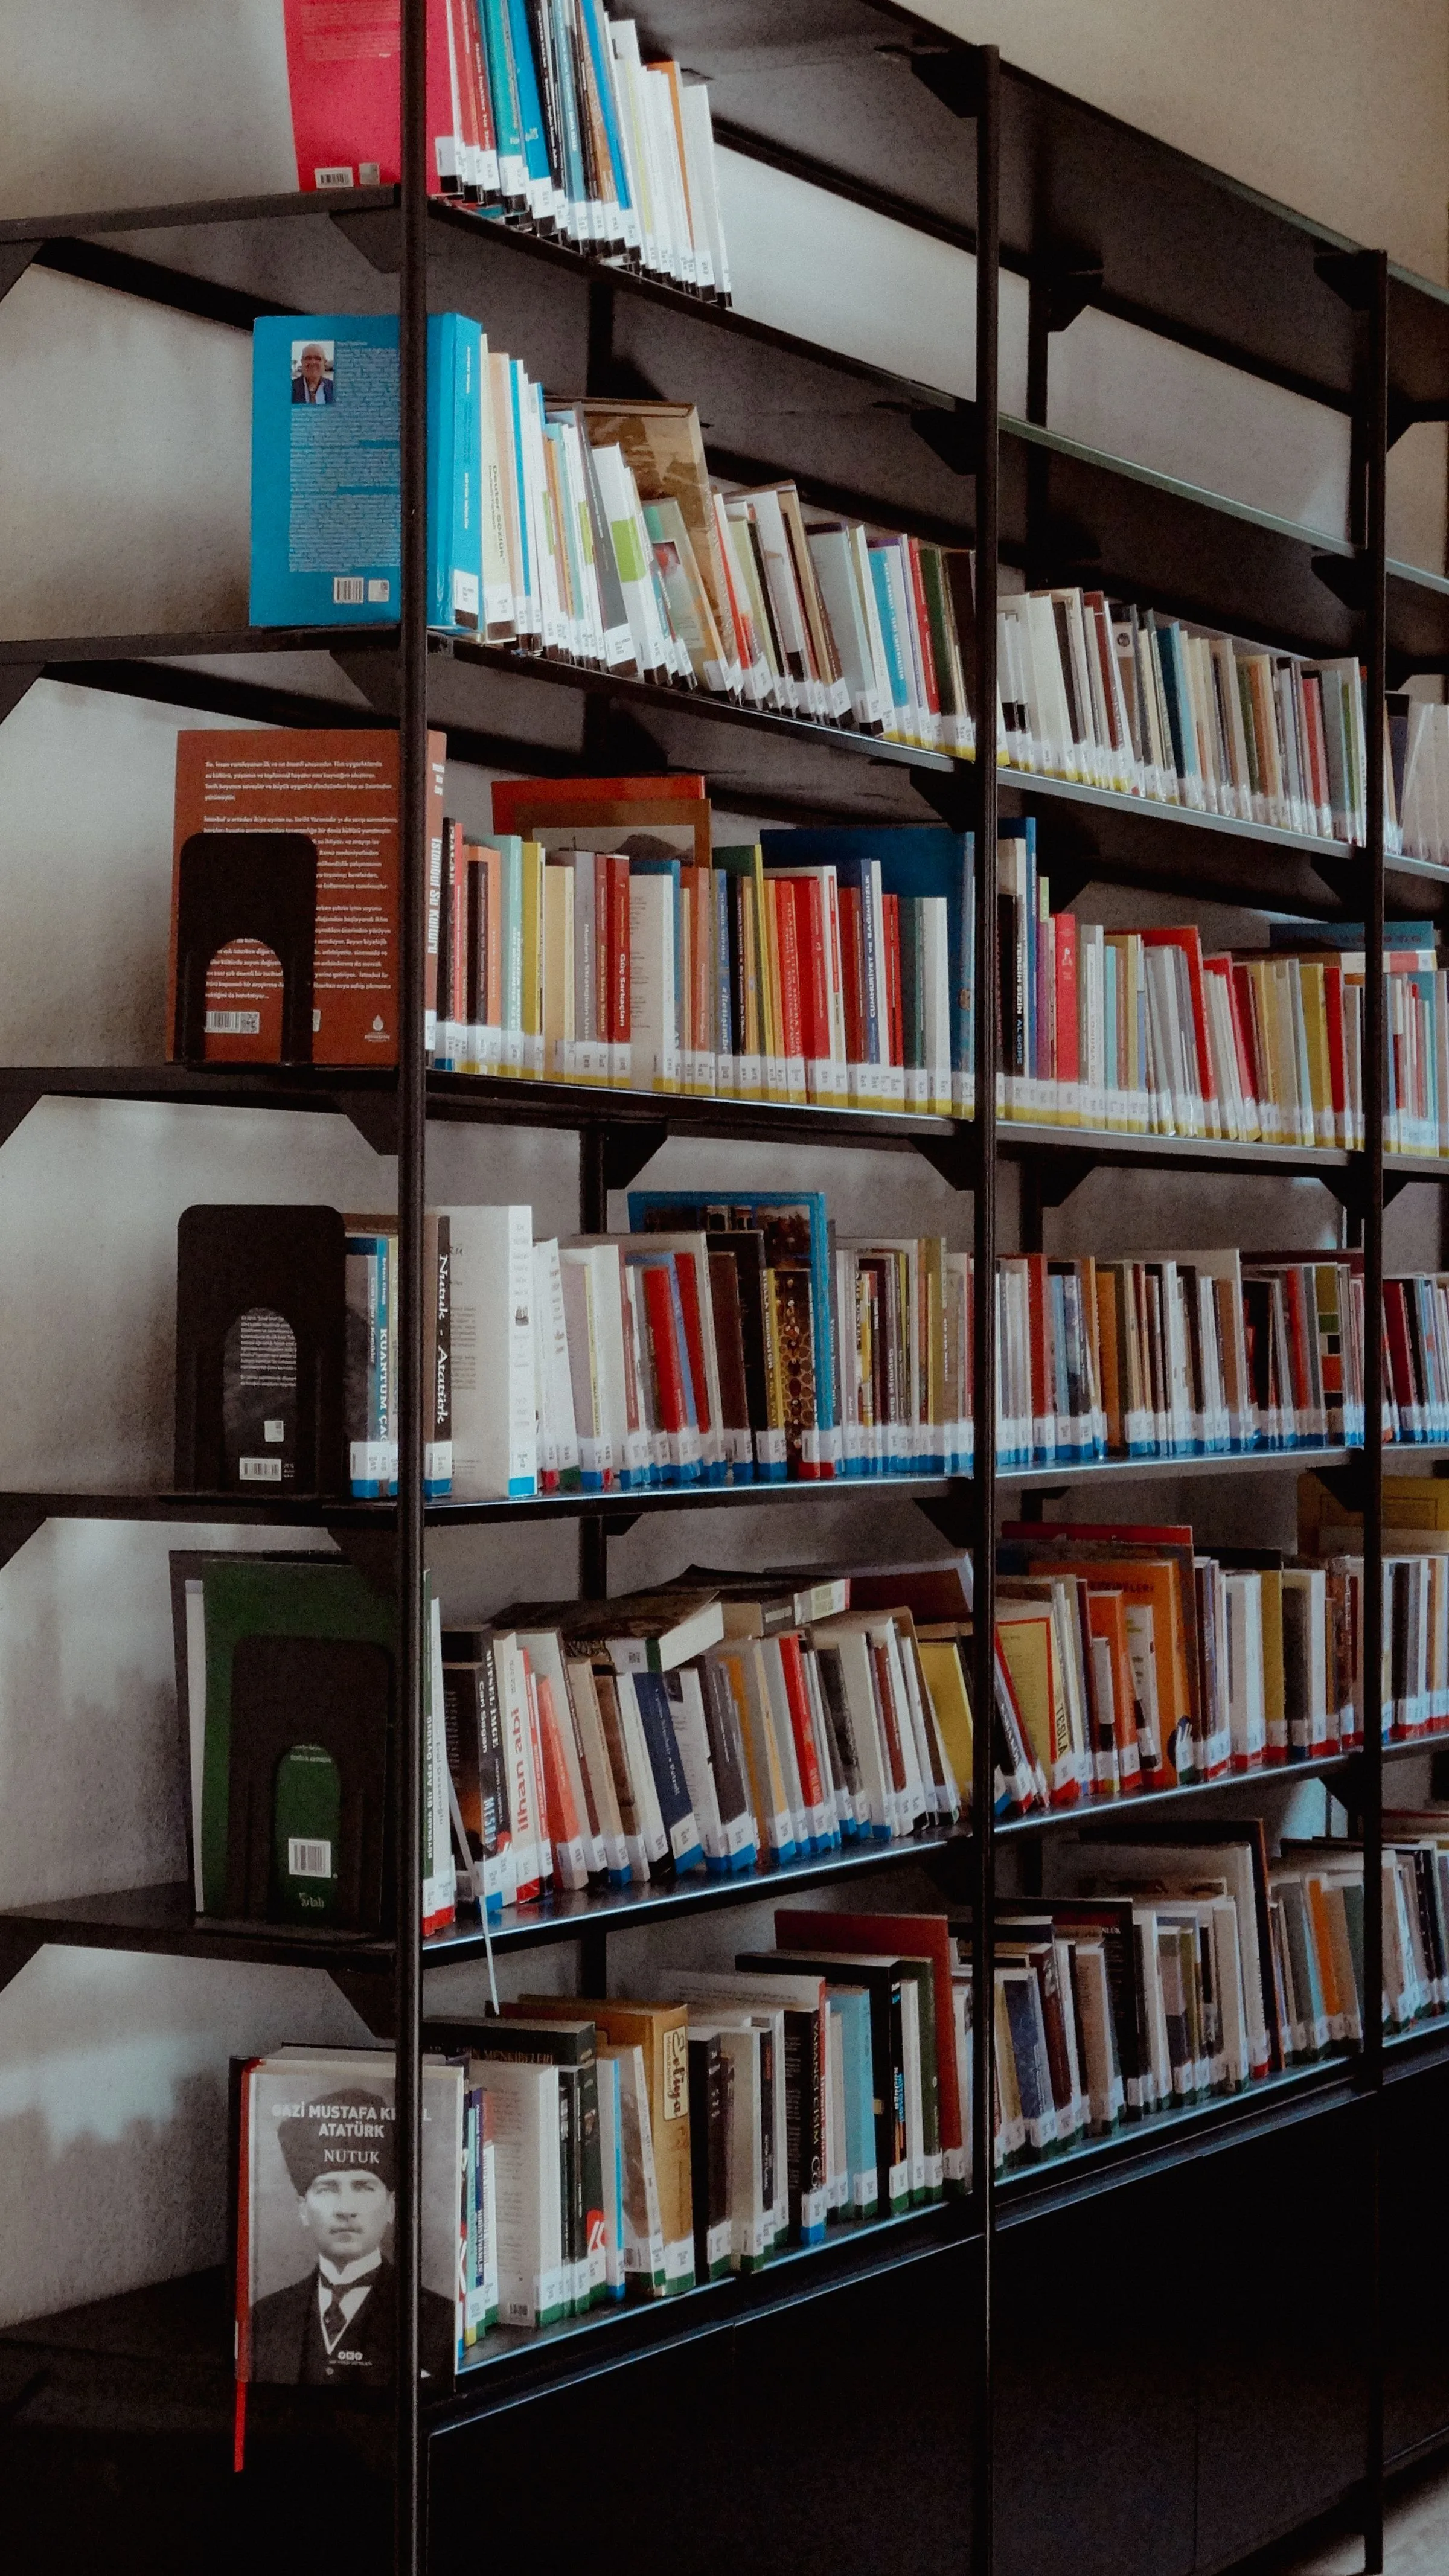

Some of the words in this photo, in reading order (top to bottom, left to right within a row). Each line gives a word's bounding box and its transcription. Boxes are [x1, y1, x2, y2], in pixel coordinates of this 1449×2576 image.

[868, 942, 873, 953] ve
[868, 957, 876, 1018] CUMHURİYET
[439, 1254, 449, 1320] Nutuk
[438, 1345, 449, 1424] Atatürk
[511, 1708, 522, 1754] abi
[1056, 1702, 1068, 1757] TESLA
[516, 1760, 529, 1833] ilhan
[272, 2101, 305, 2118] GAZİ
[308, 2105, 378, 2120] MUSTAFA
[318, 2121, 385, 2138] ATATÜRK
[324, 2148, 380, 2164] NUTUK
